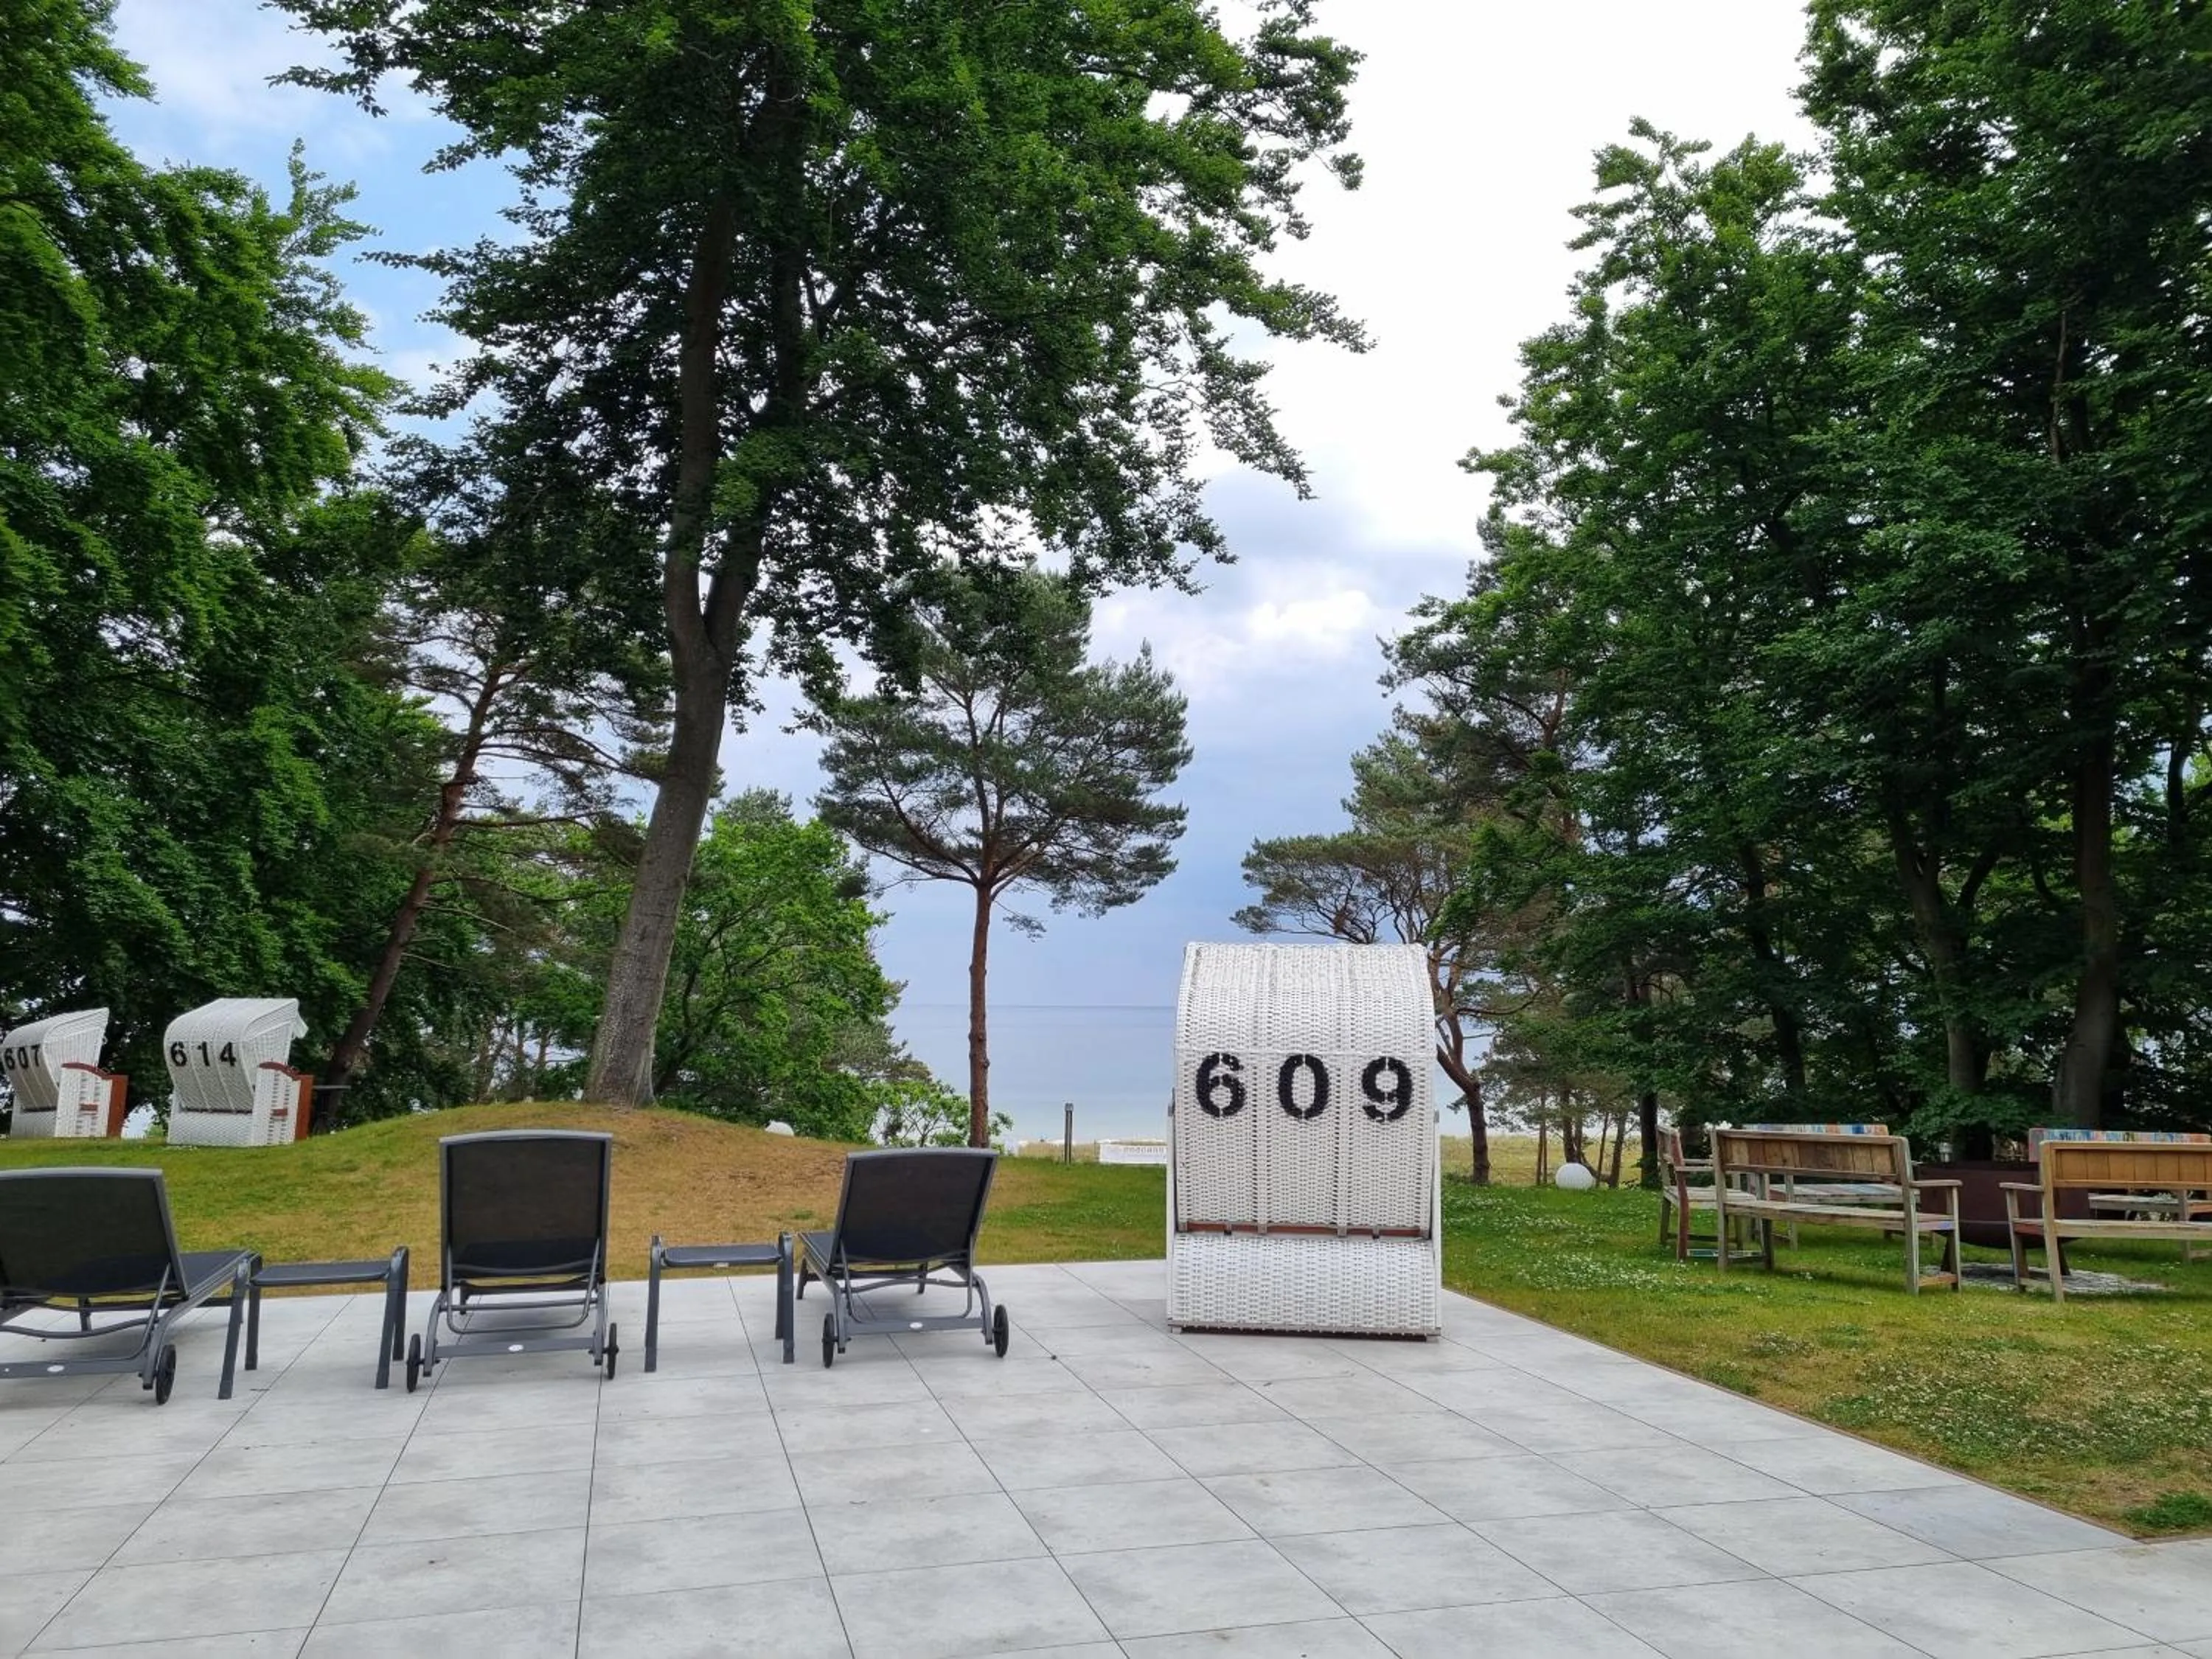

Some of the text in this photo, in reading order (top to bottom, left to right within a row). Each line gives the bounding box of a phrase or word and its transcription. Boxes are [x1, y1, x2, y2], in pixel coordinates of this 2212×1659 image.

[4, 1043, 41, 1070] 607
[170, 1040, 237, 1067] 614
[1195, 1052, 1413, 1122] 609
